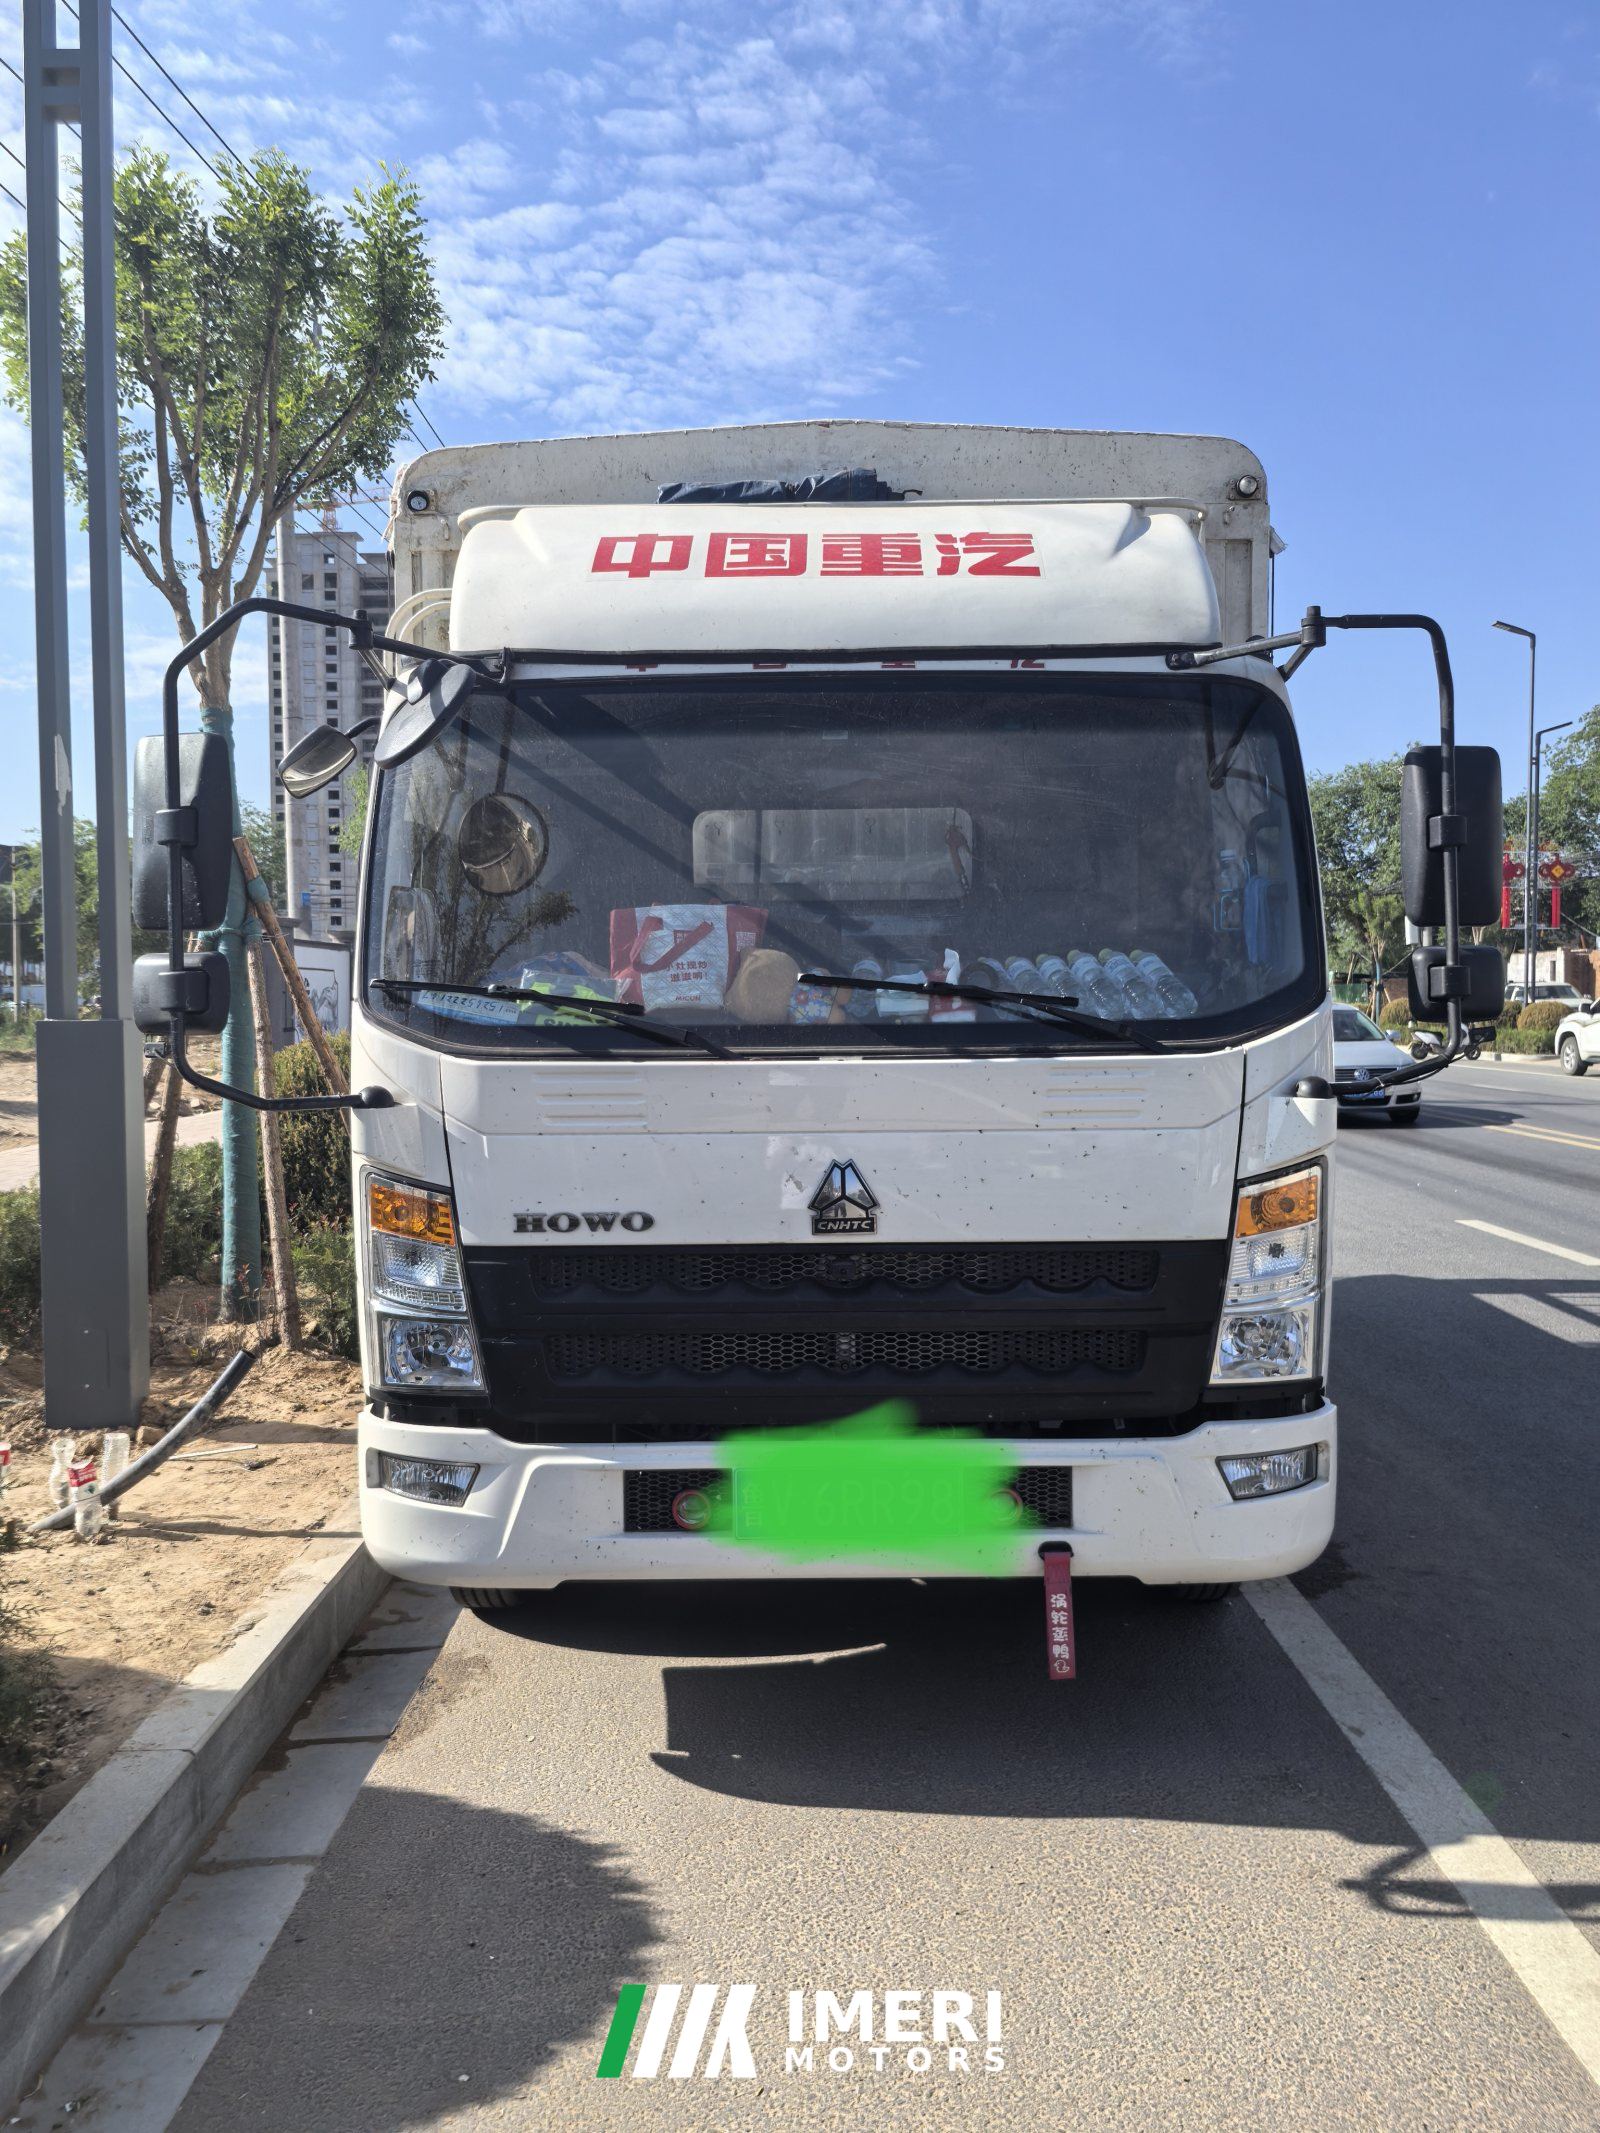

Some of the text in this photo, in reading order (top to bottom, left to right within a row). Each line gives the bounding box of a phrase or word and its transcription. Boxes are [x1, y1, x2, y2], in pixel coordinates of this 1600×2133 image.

[591, 532, 1041, 578] 中国重汽
[513, 1211, 655, 1233] HOWO
[817, 1220, 872, 1231] CNHTC
[1050, 1593, 1070, 1659] 涡轮蒸鸭
